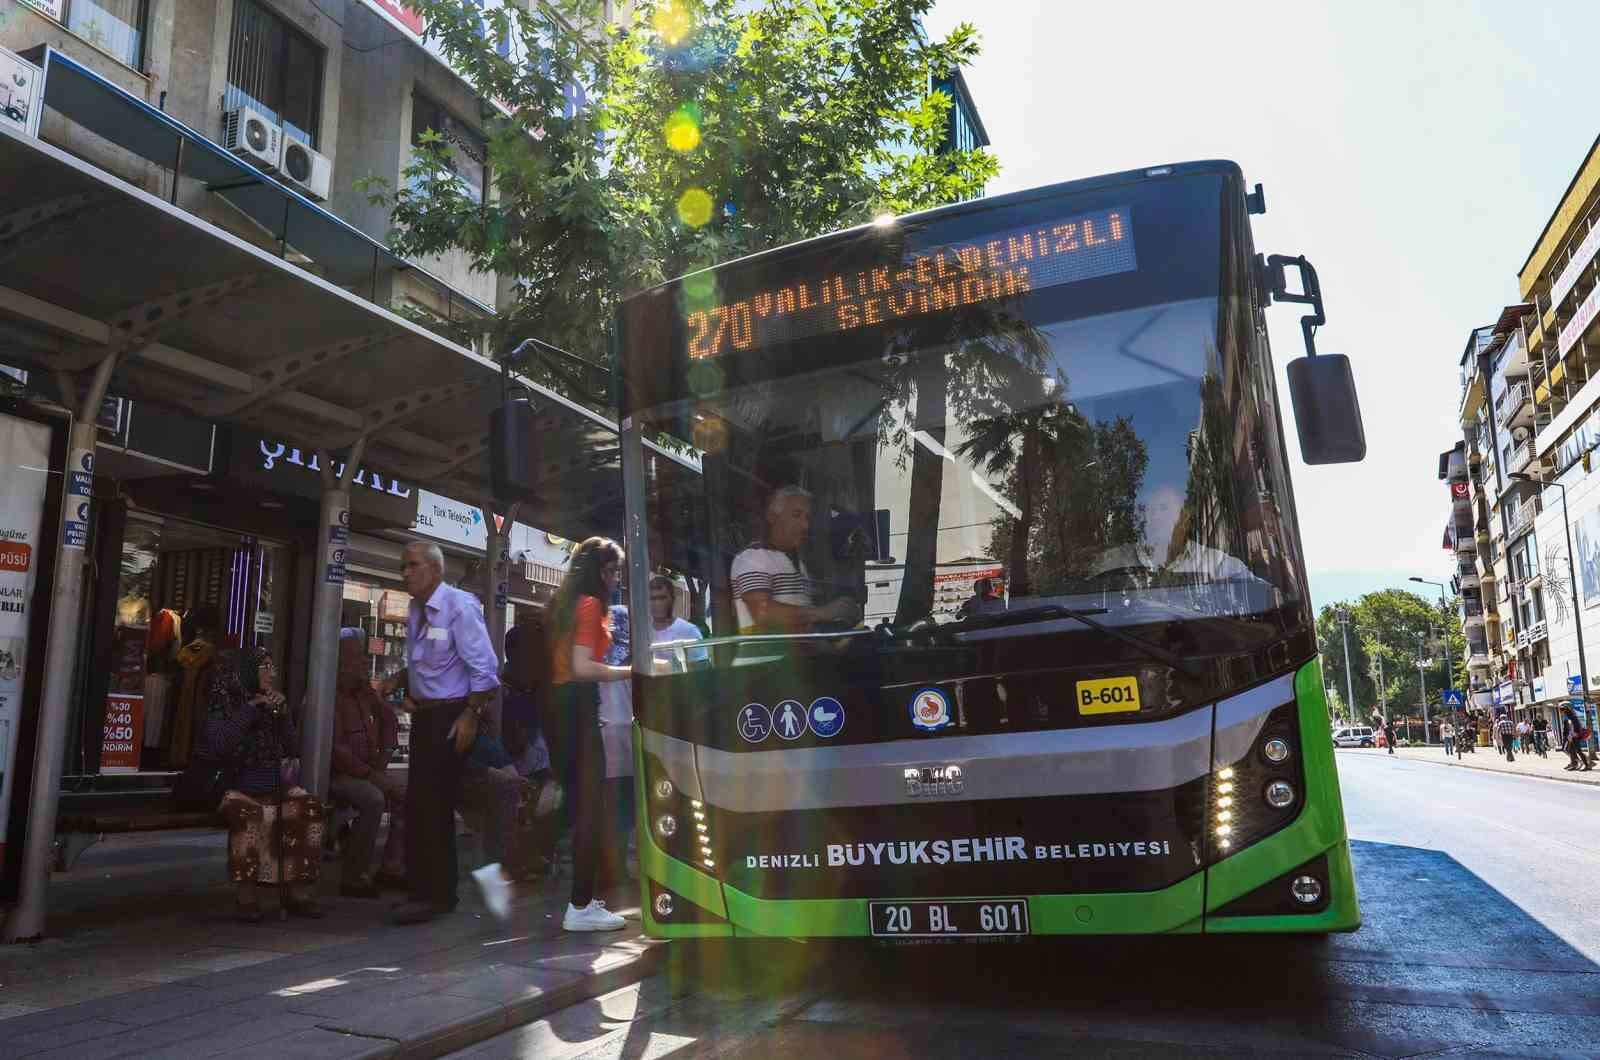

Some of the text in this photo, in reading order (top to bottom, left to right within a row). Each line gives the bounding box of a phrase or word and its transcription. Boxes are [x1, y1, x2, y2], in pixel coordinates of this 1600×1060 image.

[687, 301, 754, 360] 270
[1081, 684, 1136, 707] B-601
[107, 712, 132, 725] %40
[103, 726, 133, 741] %50
[746, 836, 1170, 869] DENİZLİ BÜYÜKŞEHİR BELEDİYESİ
[885, 904, 1022, 932] 20 BL 601
